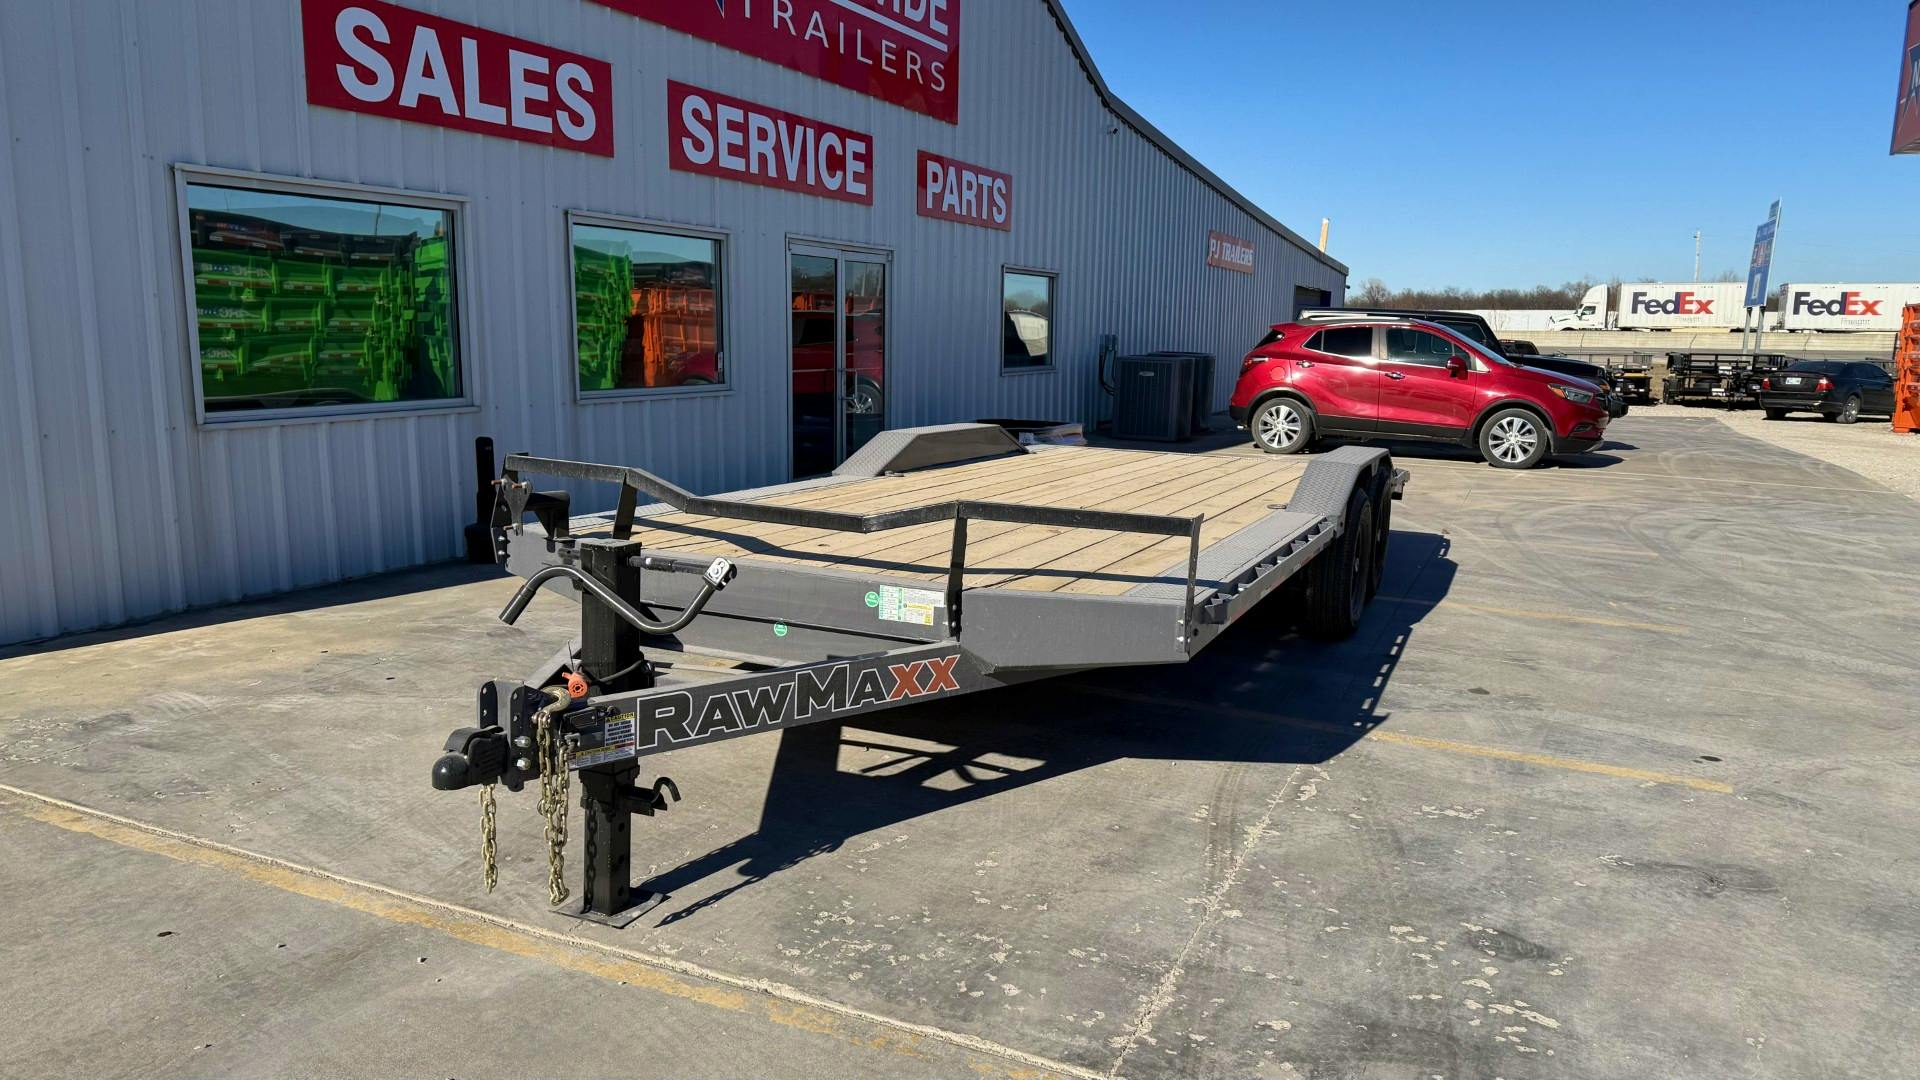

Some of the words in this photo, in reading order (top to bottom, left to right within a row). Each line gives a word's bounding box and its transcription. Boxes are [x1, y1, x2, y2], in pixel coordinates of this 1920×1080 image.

[334, 6, 597, 142] SALES
[681, 94, 867, 196] SERVICE
[926, 161, 1008, 224] PARTS
[1209, 238, 1220, 259] PJ
[1222, 242, 1254, 266] TRAILERS
[1631, 291, 1714, 315] FedEx
[1793, 291, 1883, 316] FedEx
